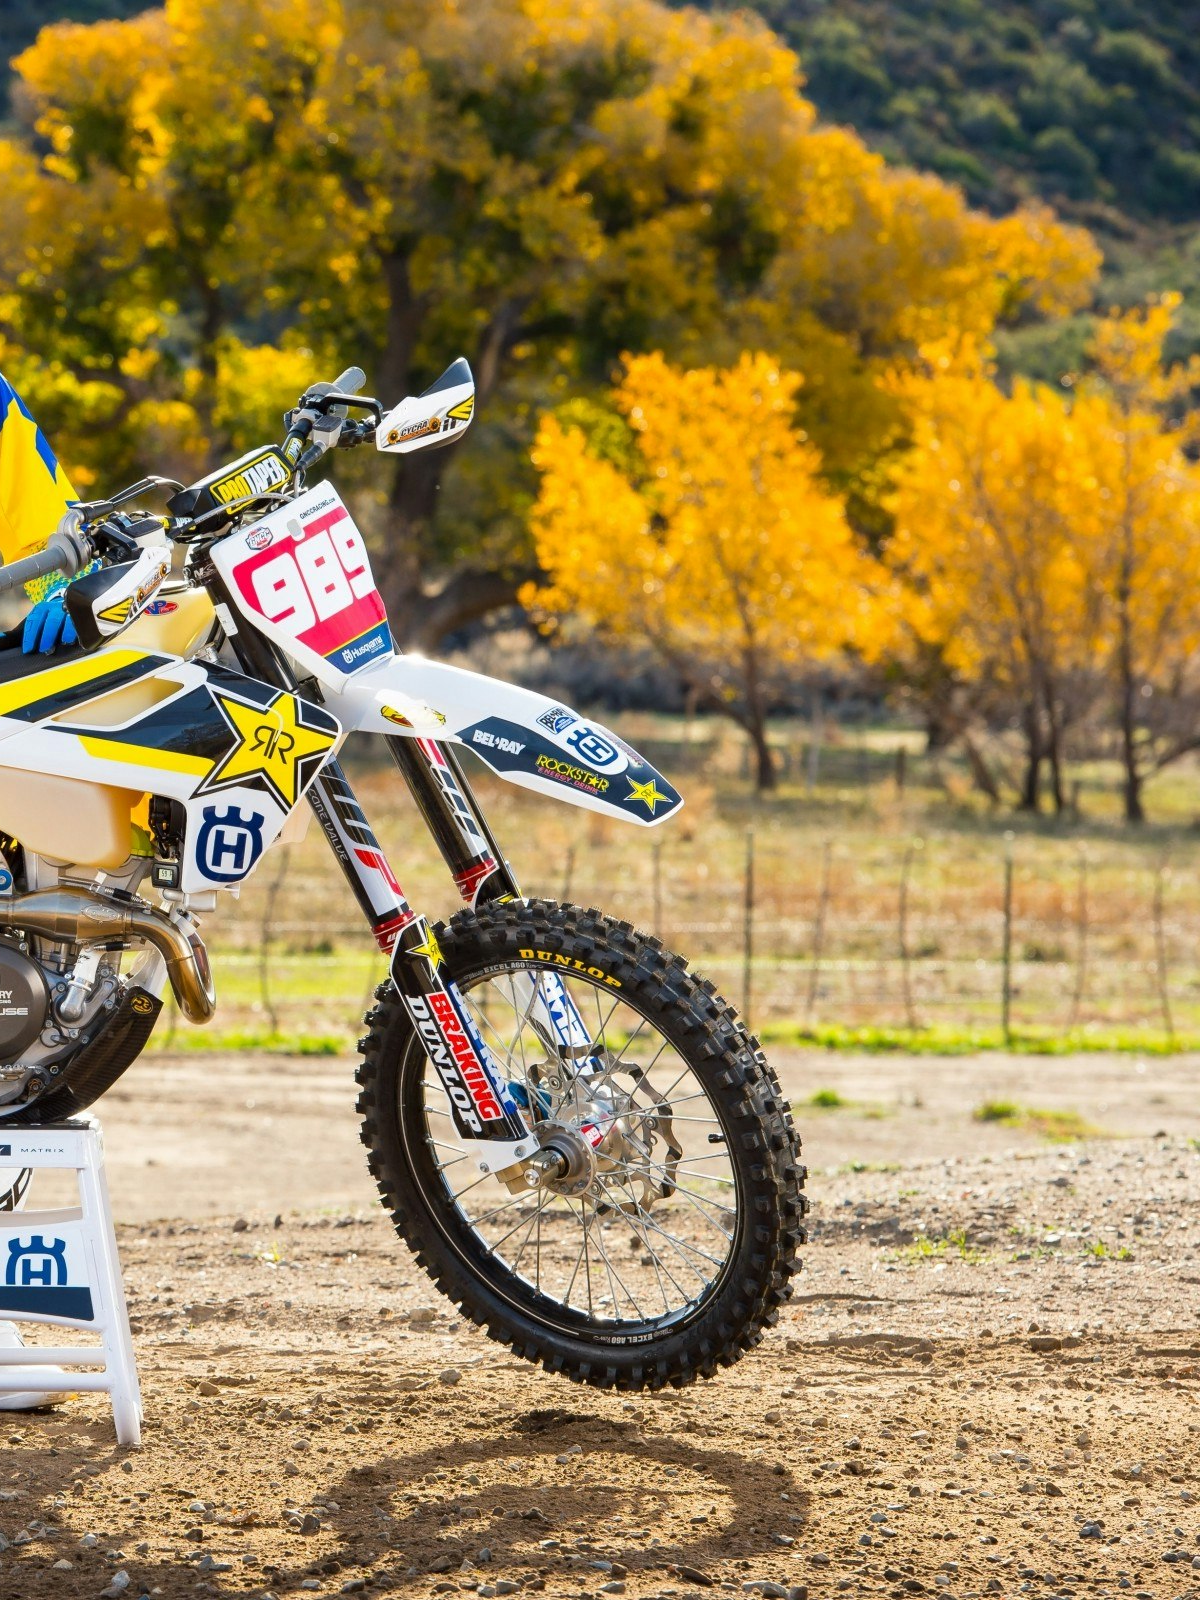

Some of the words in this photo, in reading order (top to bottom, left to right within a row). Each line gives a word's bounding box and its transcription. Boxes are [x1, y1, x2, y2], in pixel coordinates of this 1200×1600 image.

[251, 515, 377, 637] 989
[350, 635, 383, 659] Husqvarna
[538, 766, 571, 783] ENERGY
[573, 780, 600, 795] DRINK
[307, 788, 328, 821] CONE
[324, 823, 350, 862] VALVE
[483, 963, 511, 974] EXCEL
[518, 949, 622, 989] DUNLOP
[406, 993, 484, 1133] DUNLOP
[428, 992, 503, 1121] BRAKING
[626, 1333, 653, 1344] EXCEL
